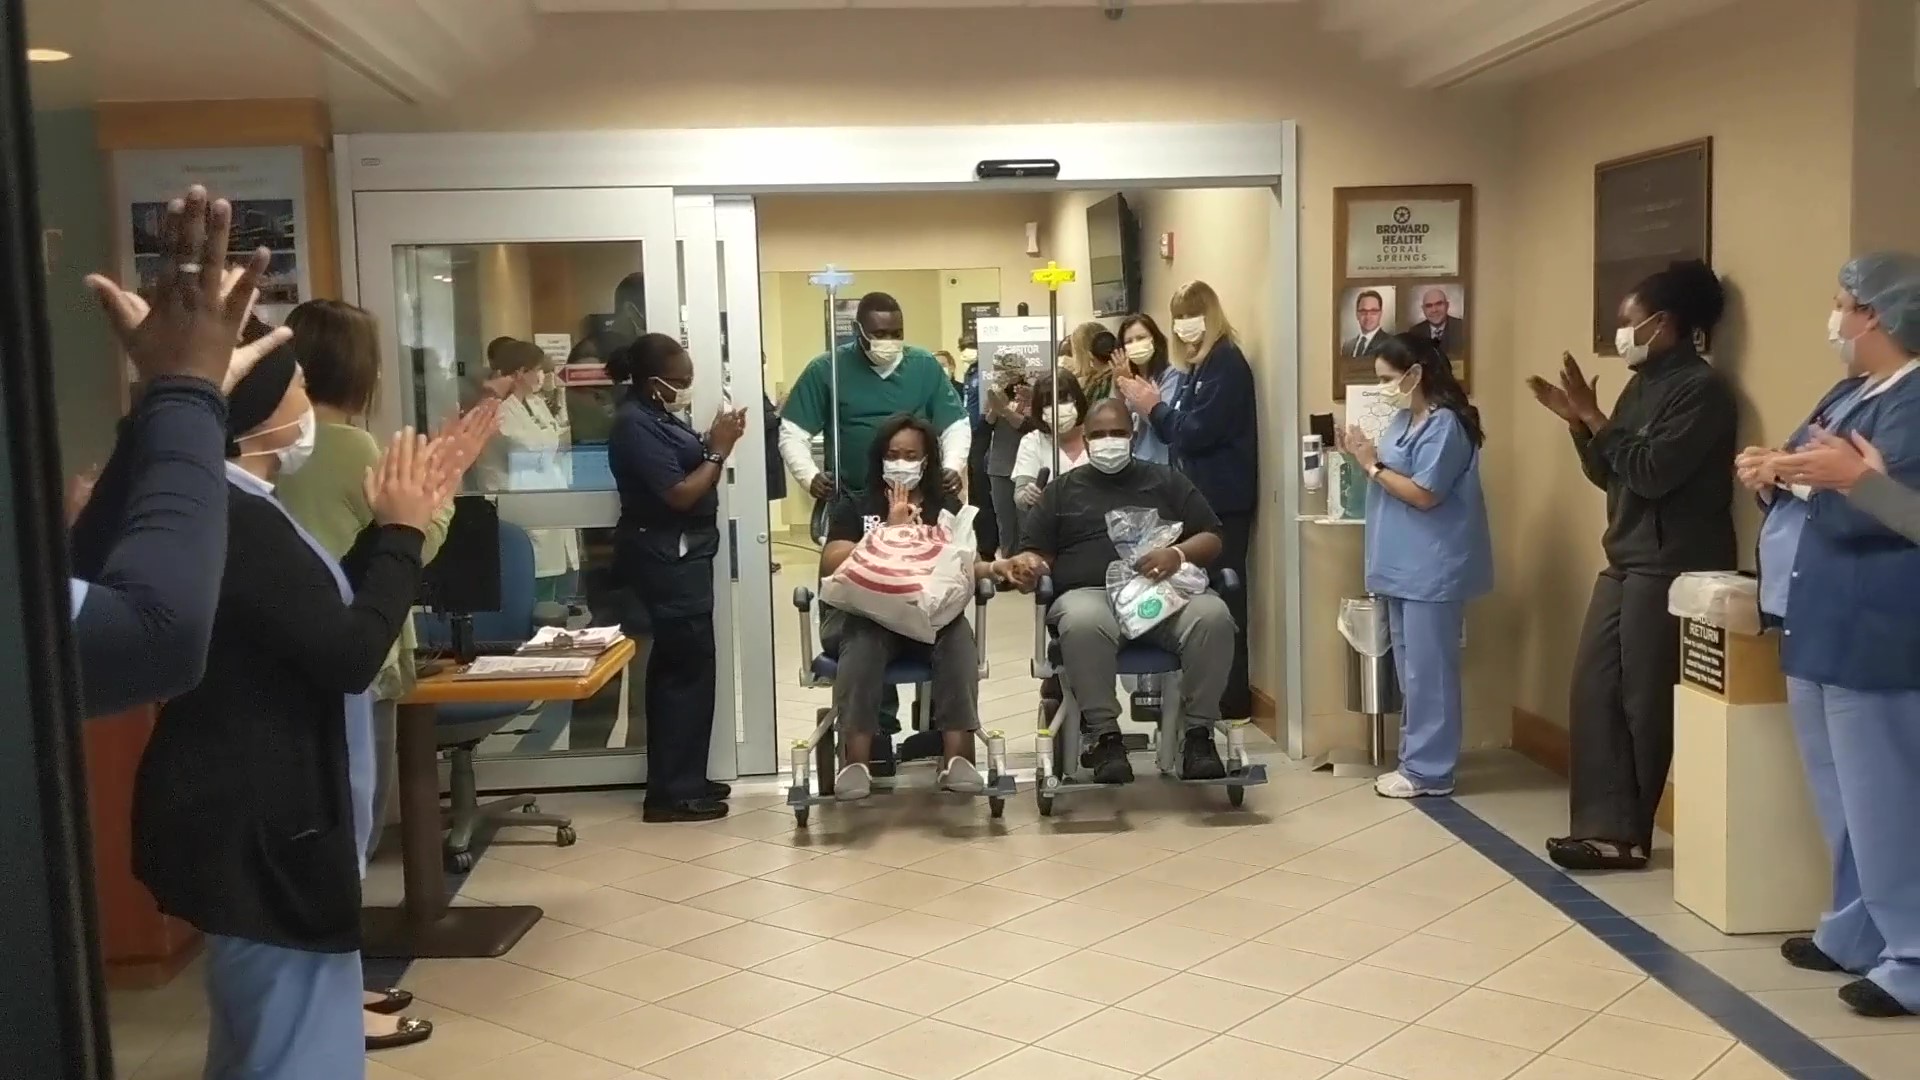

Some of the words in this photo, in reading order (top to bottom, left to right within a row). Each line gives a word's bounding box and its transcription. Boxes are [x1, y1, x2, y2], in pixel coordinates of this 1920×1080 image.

[1376, 224, 1430, 234] BROWARD
[1382, 235, 1422, 244] HEALTH
[1376, 254, 1427, 262] SPRINGS
[1690, 622, 1719, 644] RETURN
